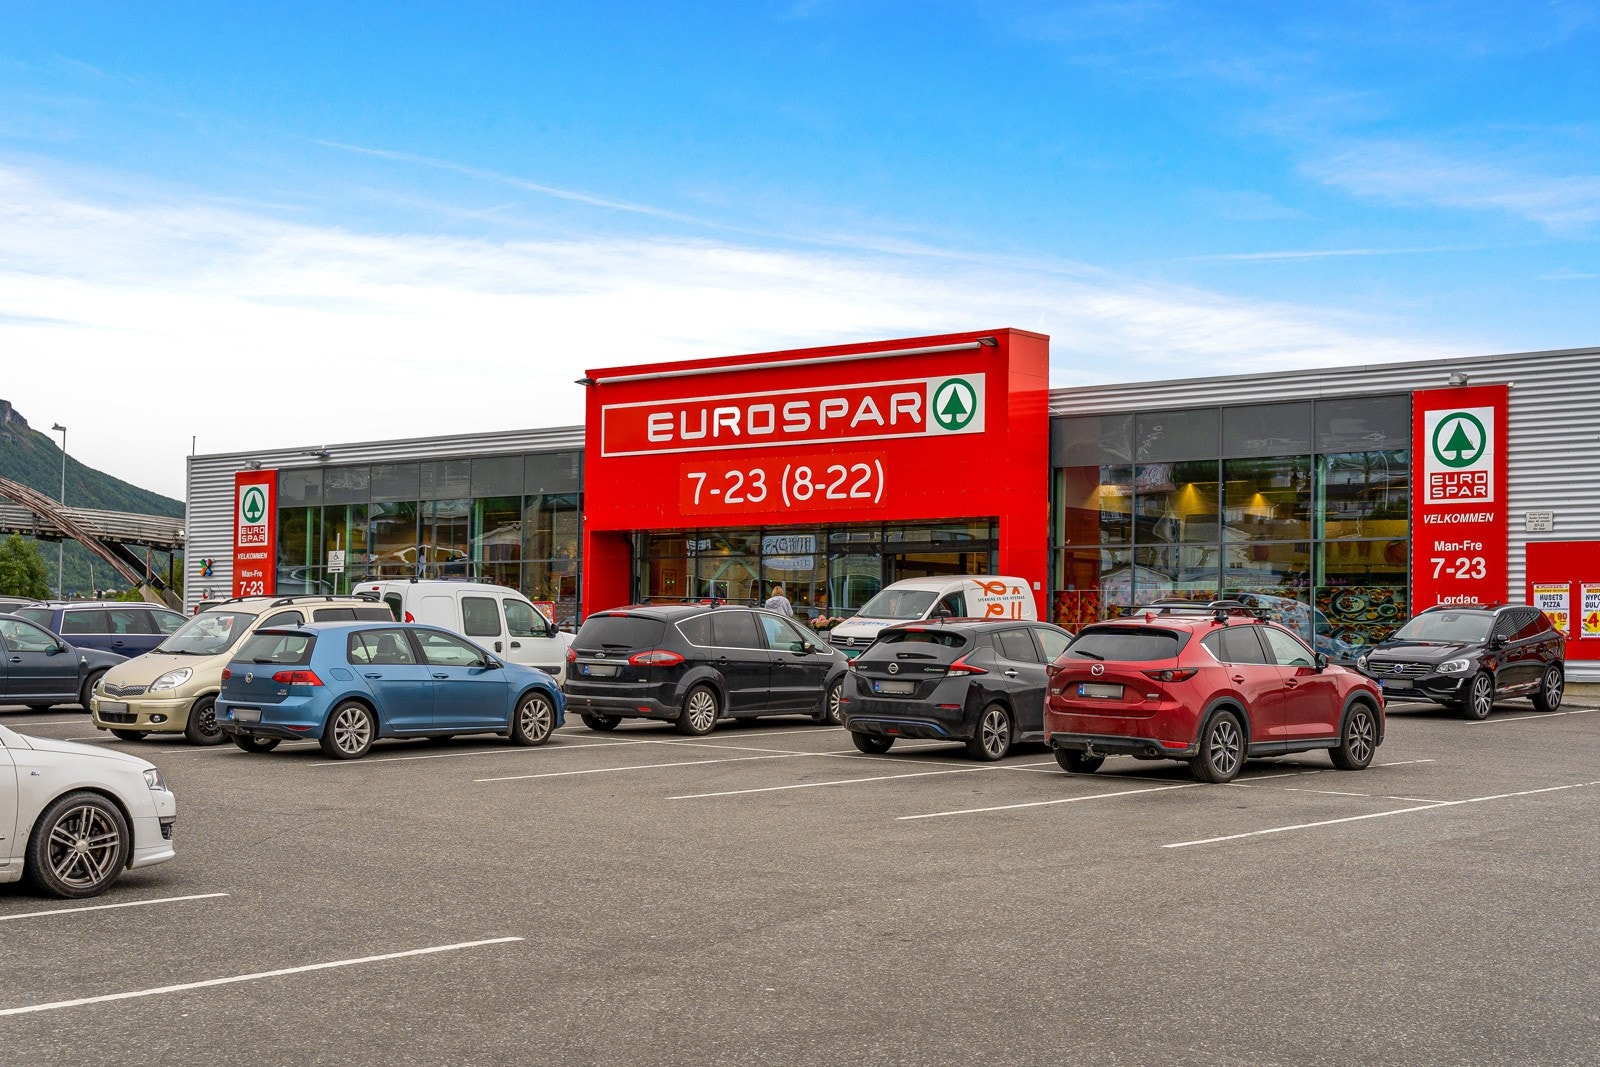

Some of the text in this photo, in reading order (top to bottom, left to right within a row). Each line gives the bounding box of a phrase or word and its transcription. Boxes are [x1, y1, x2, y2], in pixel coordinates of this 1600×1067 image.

[647, 392, 921, 442] EUROSPAR
[687, 459, 884, 507] 7-23 (8-22)
[1431, 473, 1487, 486] EURO
[1432, 485, 1486, 498] SPAR
[1423, 512, 1494, 524] VELKOMMEN
[241, 526, 265, 535] EURO
[241, 534, 265, 543] SPAR
[1434, 540, 1482, 551] Man-Fre
[237, 552, 268, 560] VELKOMMEN
[241, 570, 263, 578] Man-Fre
[1430, 557, 1486, 579] 7-23
[240, 581, 264, 596] 7-23
[1437, 594, 1478, 605] Lørdag
